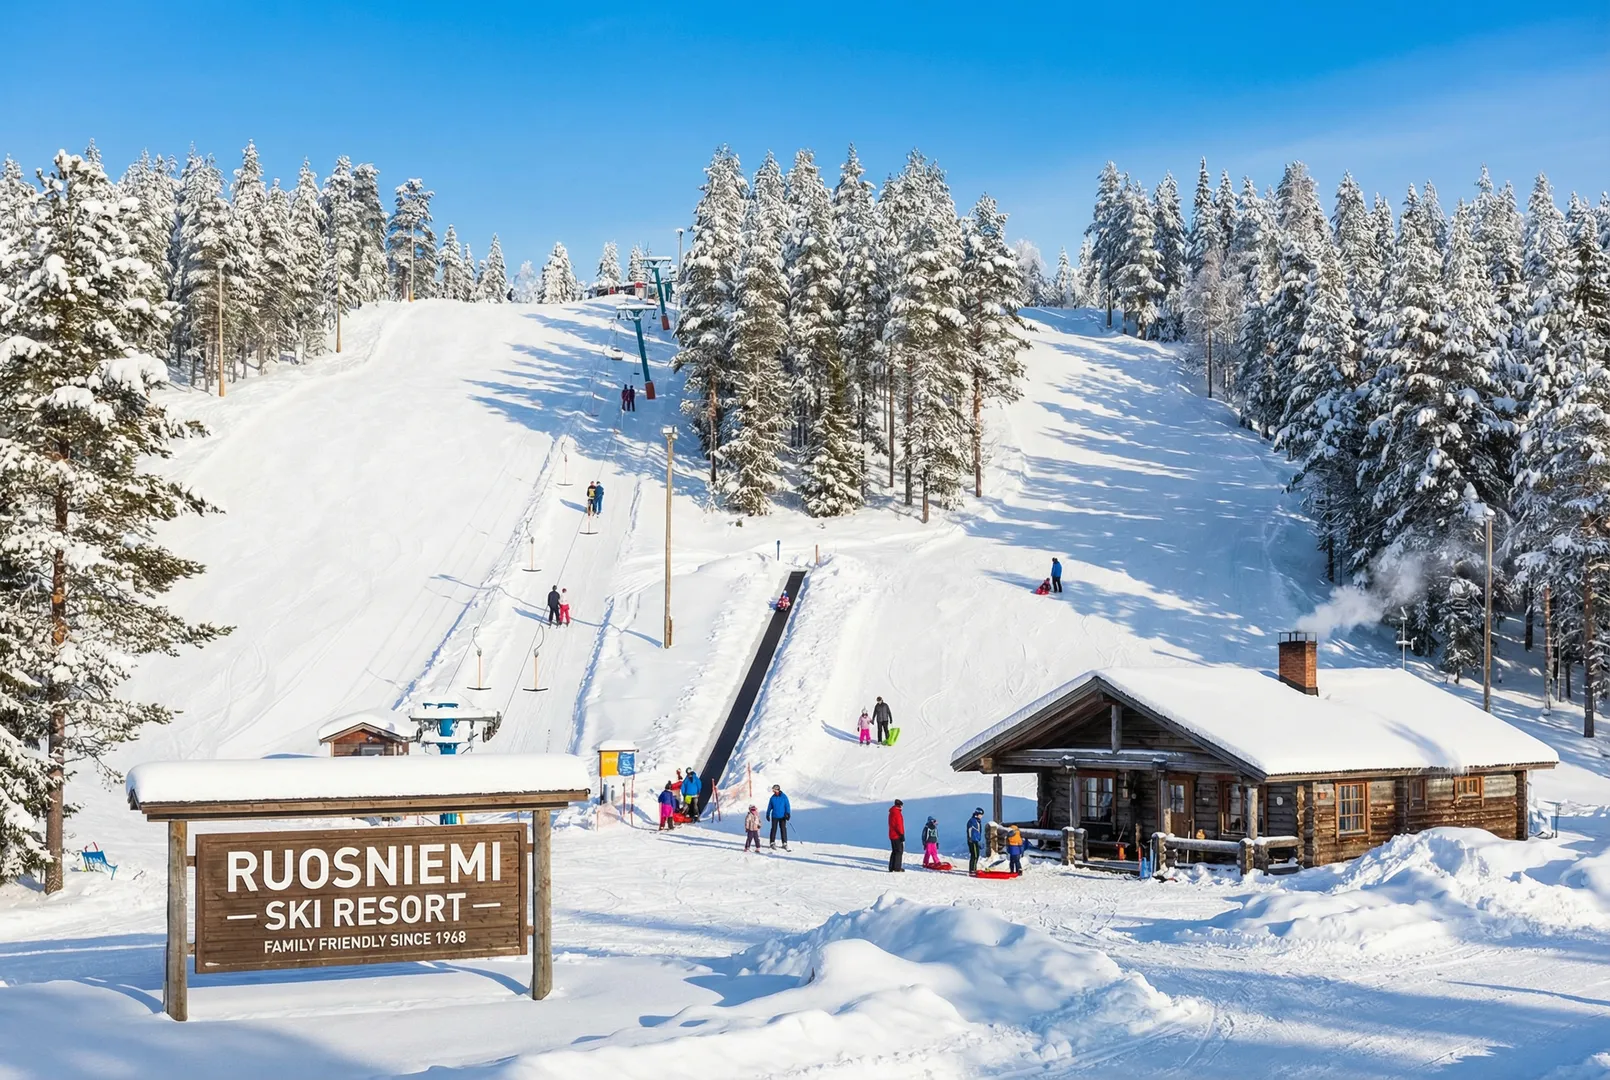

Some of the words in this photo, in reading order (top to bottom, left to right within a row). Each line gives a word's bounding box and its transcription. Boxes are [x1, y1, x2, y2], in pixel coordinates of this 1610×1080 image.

[227, 841, 501, 893] RUOSNIEMI
[264, 900, 321, 931] SKI
[333, 892, 467, 927] RESORT
[264, 938, 316, 954] FAMILY
[319, 934, 387, 951] FRIENDLY
[390, 932, 432, 947] SINCE
[435, 930, 467, 944] 1968
